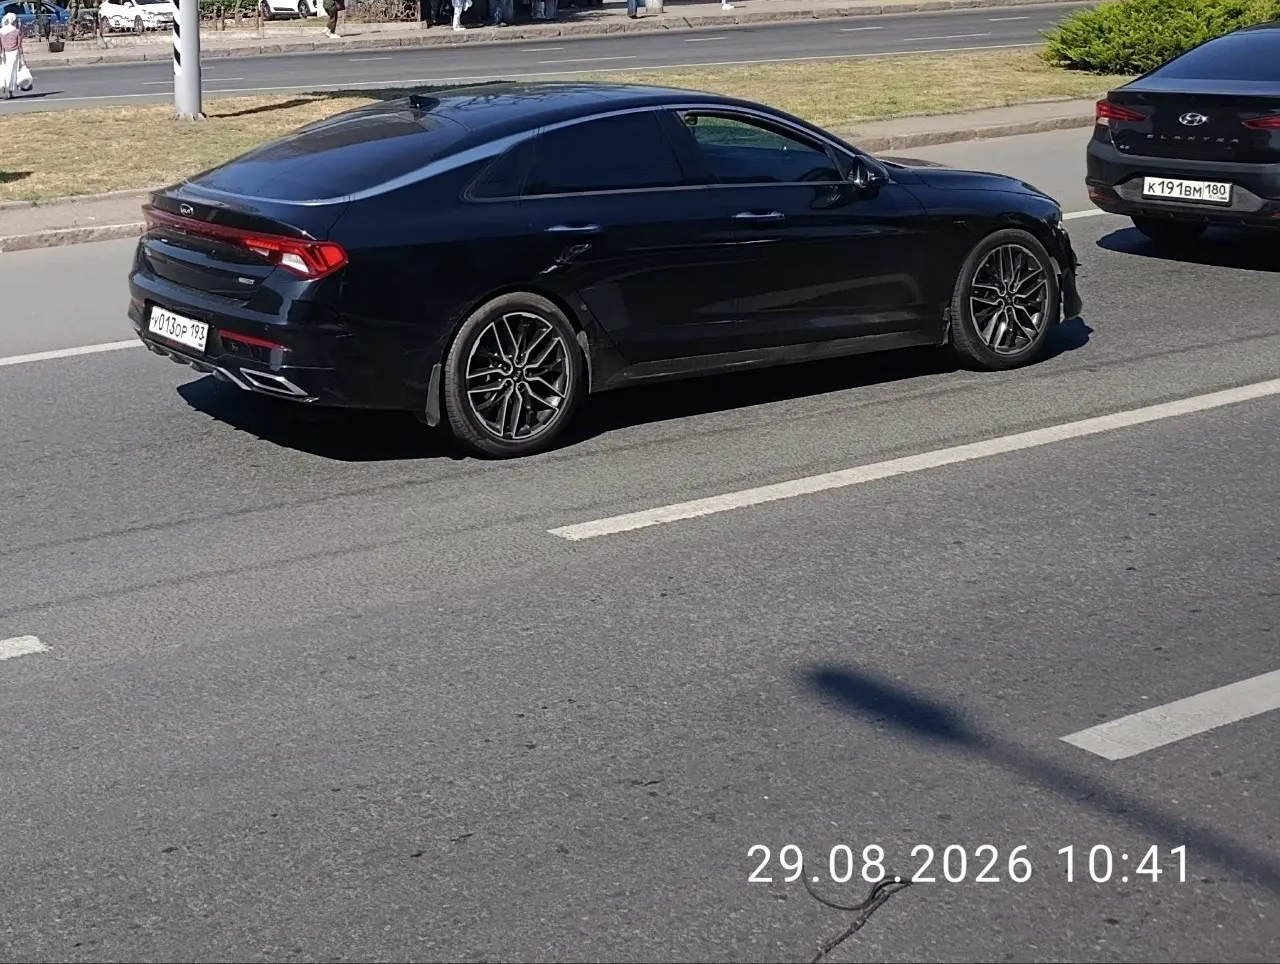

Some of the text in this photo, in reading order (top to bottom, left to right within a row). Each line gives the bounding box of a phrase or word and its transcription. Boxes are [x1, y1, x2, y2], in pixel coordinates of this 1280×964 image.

[1146, 134, 1240, 144] ELANTRA
[1148, 181, 1227, 198] К191ВМ 180
[190, 323, 205, 341] 193
